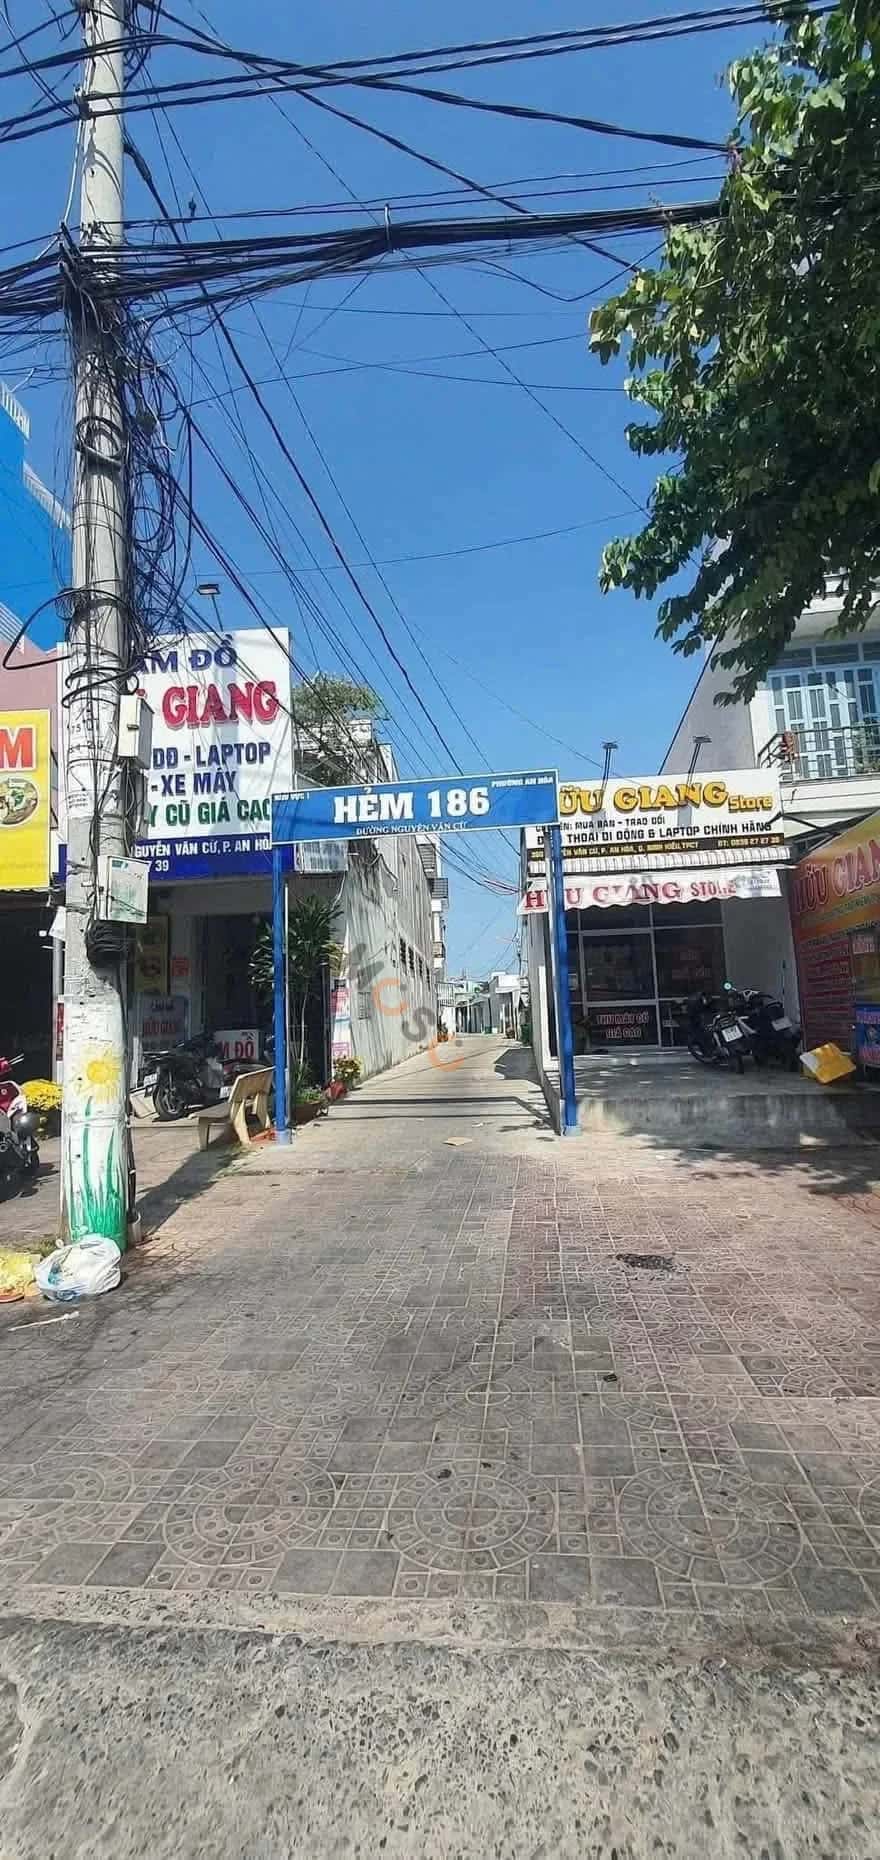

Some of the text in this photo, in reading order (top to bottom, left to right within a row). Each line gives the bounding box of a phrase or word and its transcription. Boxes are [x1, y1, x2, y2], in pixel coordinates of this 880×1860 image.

[189, 634, 238, 671] ĐỒ
[162, 681, 279, 727] GIANG
[196, 742, 271, 768] LAPTOP
[161, 773, 186, 797] XE
[193, 768, 237, 795] MÁY
[165, 800, 191, 826] CŨ
[198, 796, 231, 824] GIÁ
[334, 786, 490, 824] HẺM 186
[559, 782, 773, 815] ỮU GIANG Store
[575, 821, 596, 830] MUA
[626, 817, 648, 826] TRAO
[602, 831, 612, 841] DI
[659, 826, 700, 838] LAPTOP
[704, 822, 738, 835] CHÍNH
[130, 841, 171, 858] GUYỄN
[234, 840, 250, 852] AN
[155, 860, 169, 871] 39
